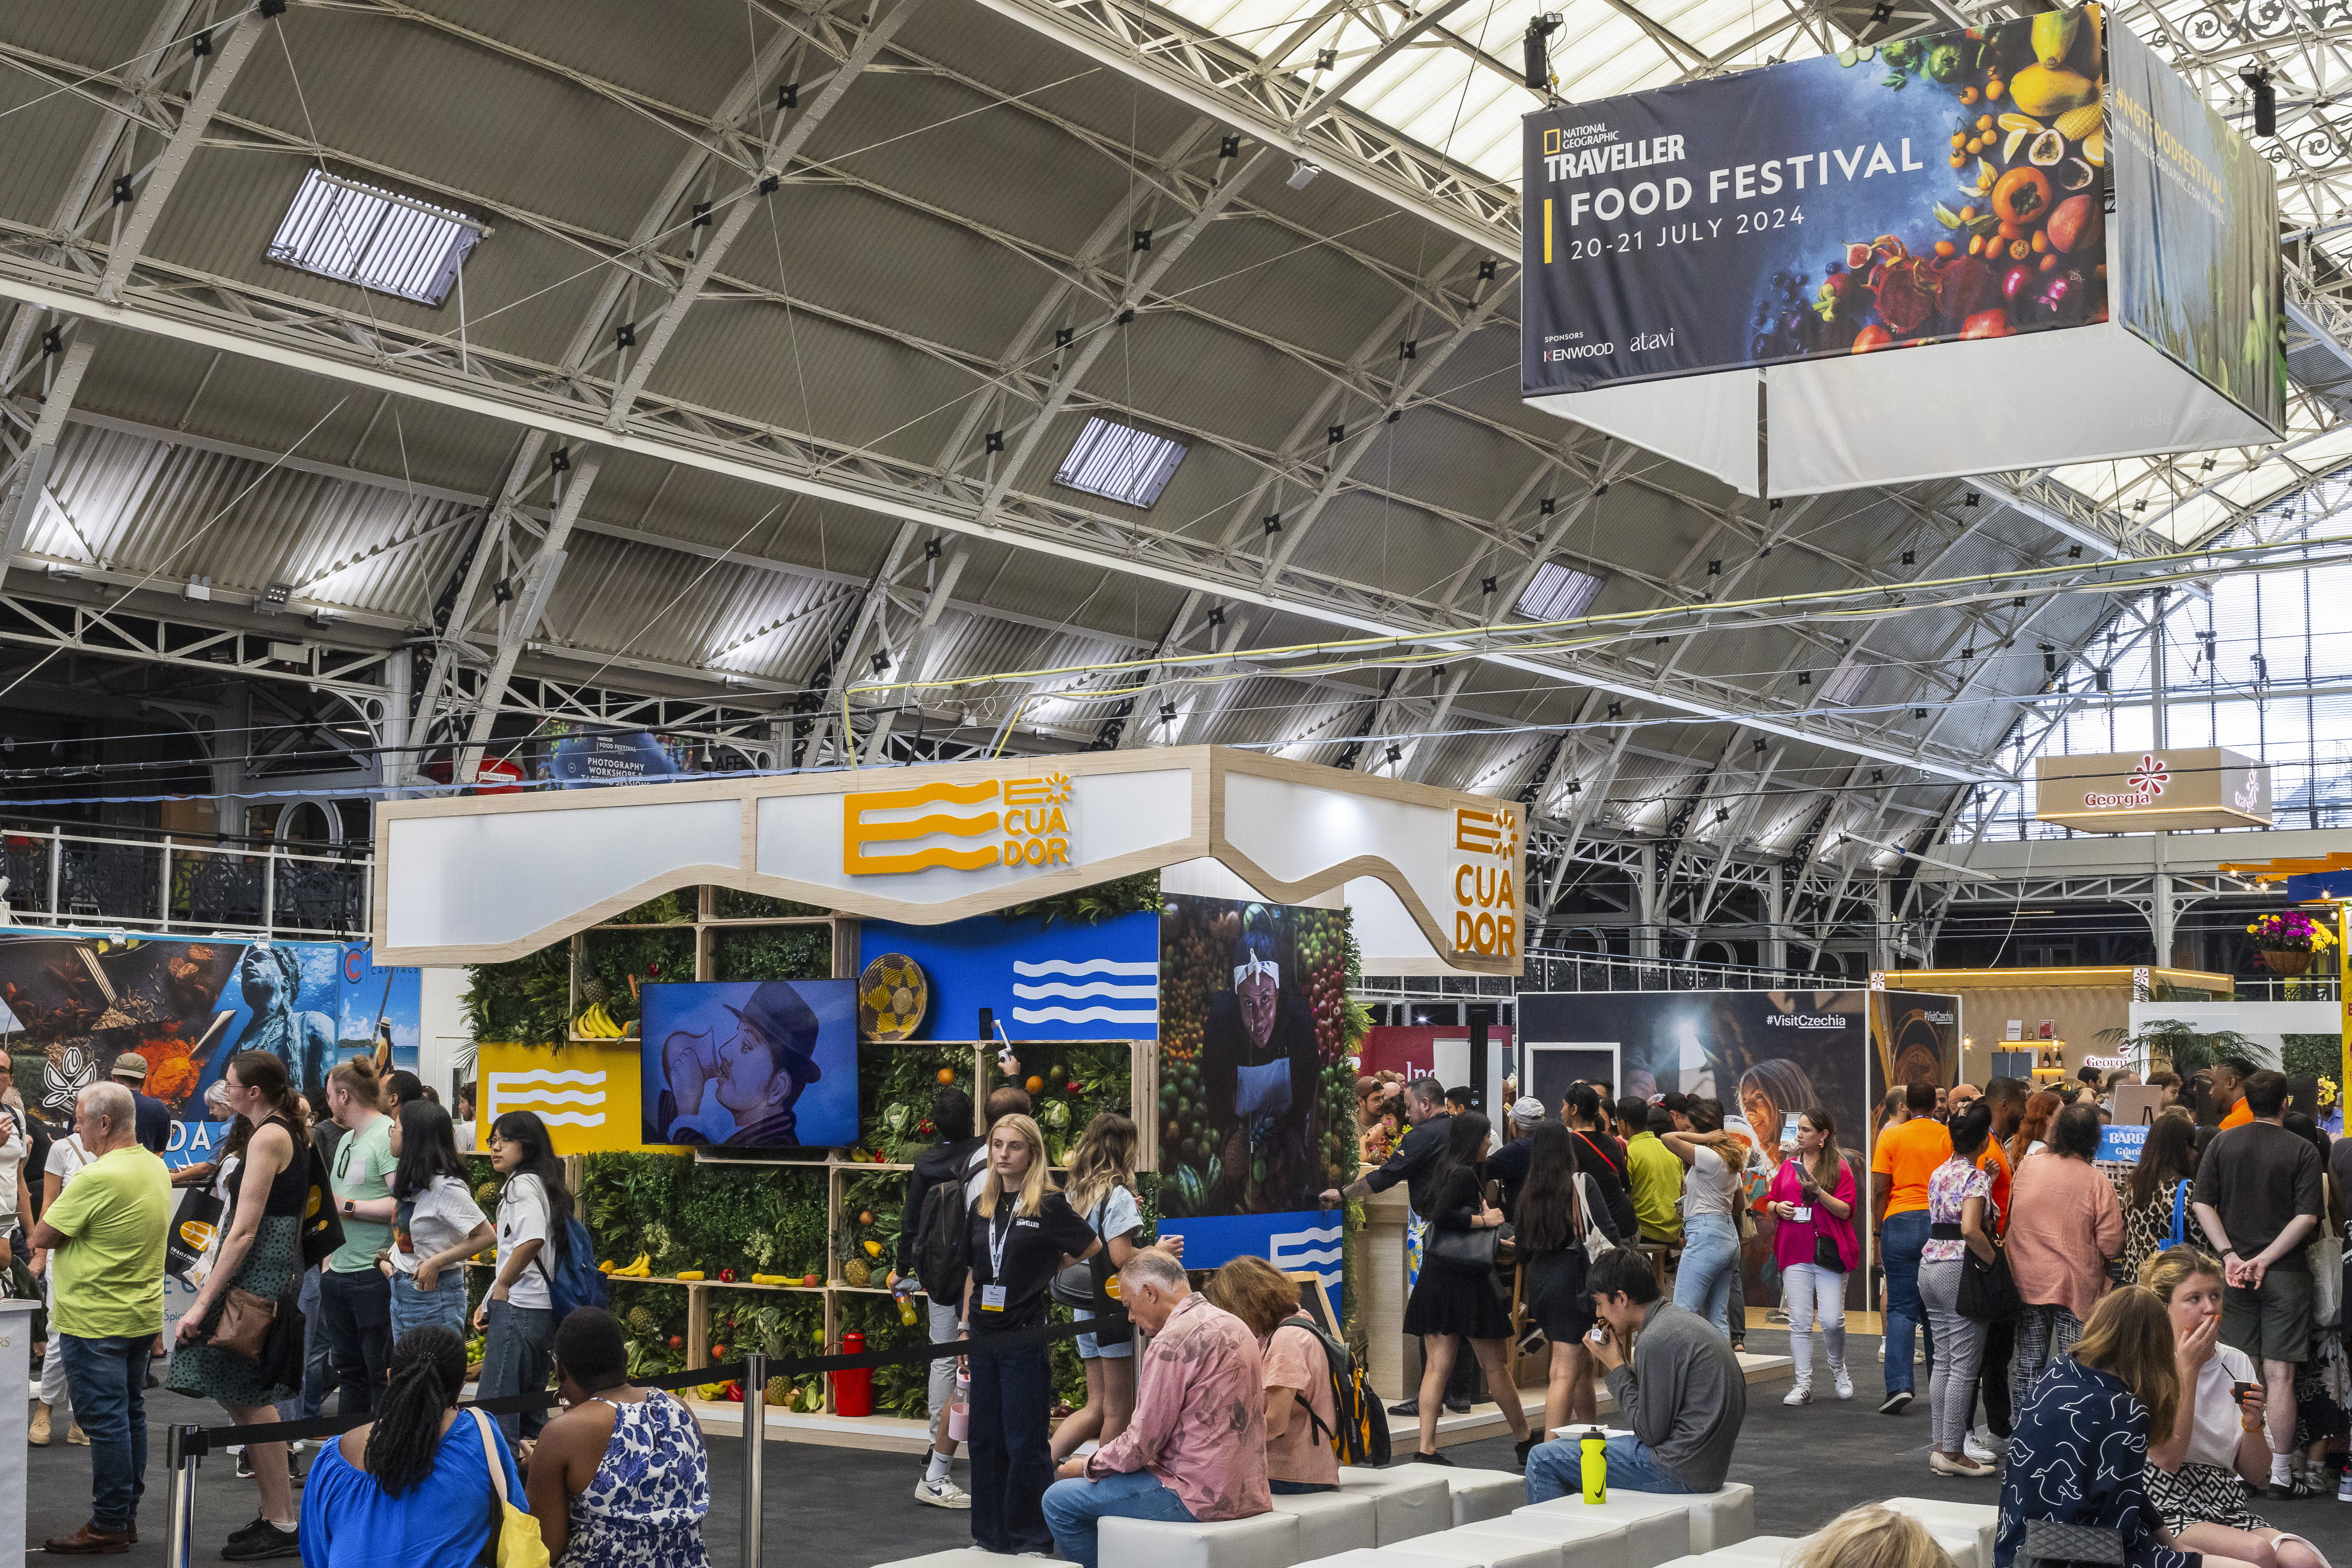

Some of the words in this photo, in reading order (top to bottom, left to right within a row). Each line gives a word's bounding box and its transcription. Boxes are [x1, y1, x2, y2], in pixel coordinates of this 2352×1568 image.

[1563, 123, 1607, 139] NATIONAL
[1563, 130, 1619, 150] GEOGRAPHIC
[2115, 87, 2224, 203] #NGTFOODFESTIVAL
[1544, 134, 1685, 182] TRAVELLER
[1571, 177, 1693, 226] FOOD
[1710, 137, 1923, 204] FESTIVAL
[1571, 231, 1643, 260] 20-21
[1657, 218, 1723, 247] JULY
[1737, 205, 1804, 235] 2024
[1544, 332, 1584, 343] SPONSORS
[1544, 343, 1614, 362] KENWOOD
[1630, 328, 1675, 352] atavi
[588, 757, 644, 771] PHOTOGRAPHY
[712, 755, 742, 770] AFE
[589, 766, 636, 777] WORKSHOPS
[2085, 791, 2149, 807] Georgia
[371, 966, 419, 975] CAPTALS
[1767, 1014, 1846, 1027] #VisitCzechia
[1924, 1011, 1953, 1022] #VisitCzechia
[2086, 1057, 2130, 1070] Georgi
[163, 1309, 185, 1323] Spic
